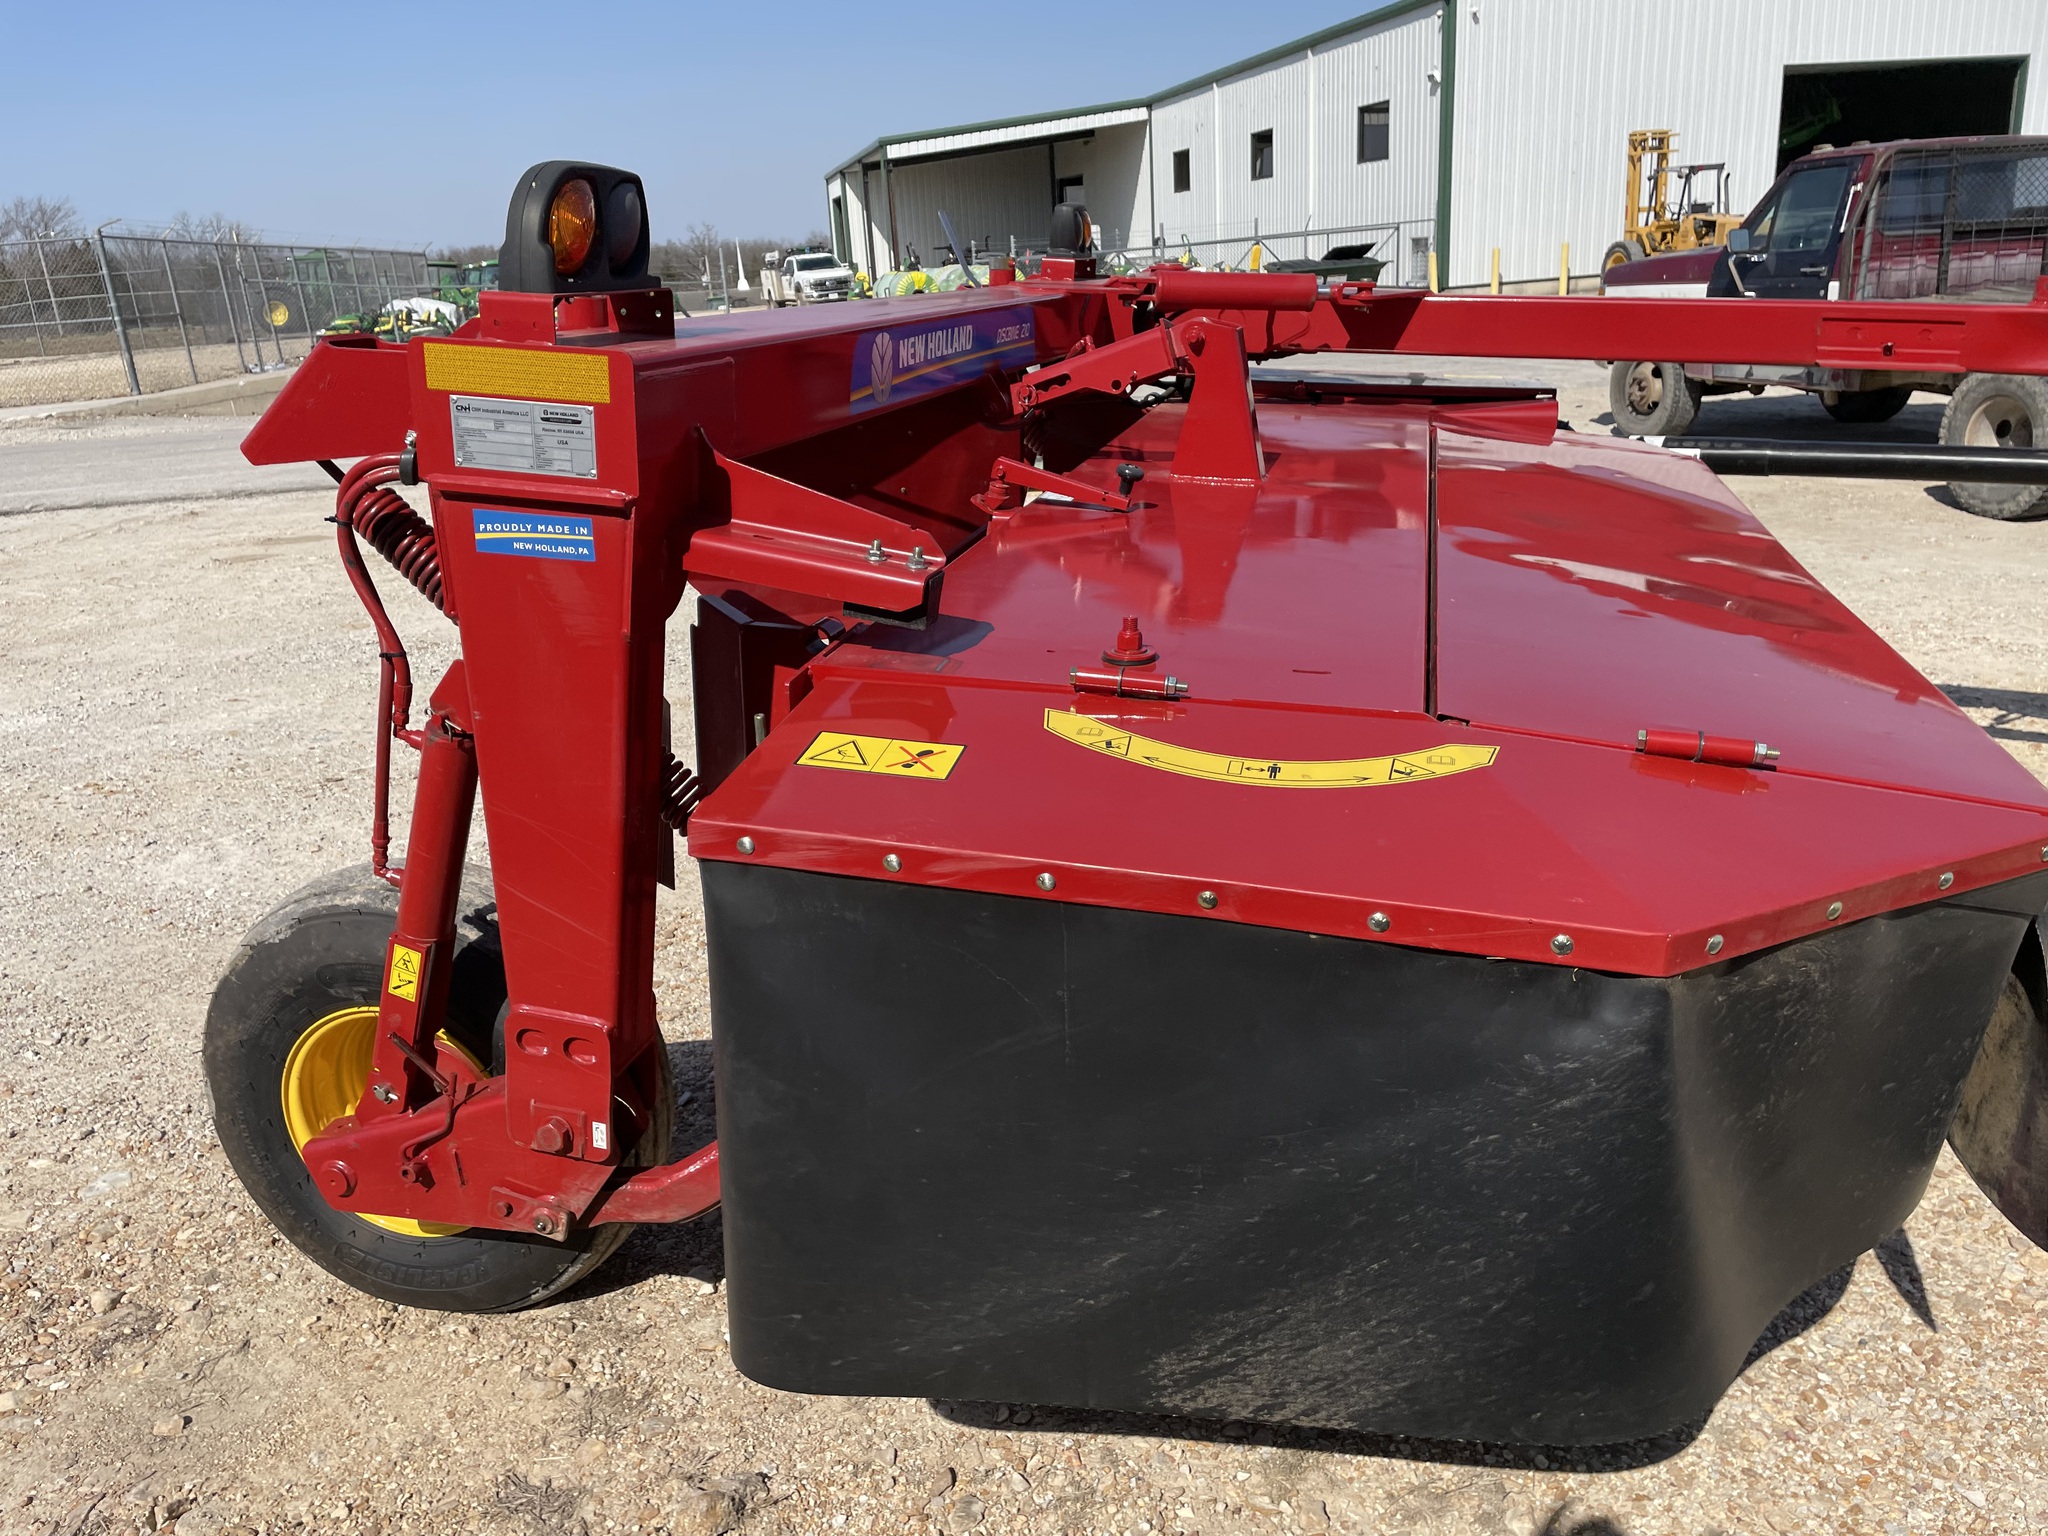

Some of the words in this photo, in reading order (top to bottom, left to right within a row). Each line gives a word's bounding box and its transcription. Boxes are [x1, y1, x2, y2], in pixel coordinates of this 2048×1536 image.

[899, 334, 926, 368] NEW
[927, 324, 973, 360] HOLLAND
[479, 523, 532, 532] PROUDLY
[537, 524, 570, 534] MADE
[575, 526, 588, 535] IN
[513, 541, 533, 550] NEW
[535, 544, 578, 555] HOLLAND,
[578, 547, 589, 555] PA
[341, 1247, 477, 1287] CARLISLE
